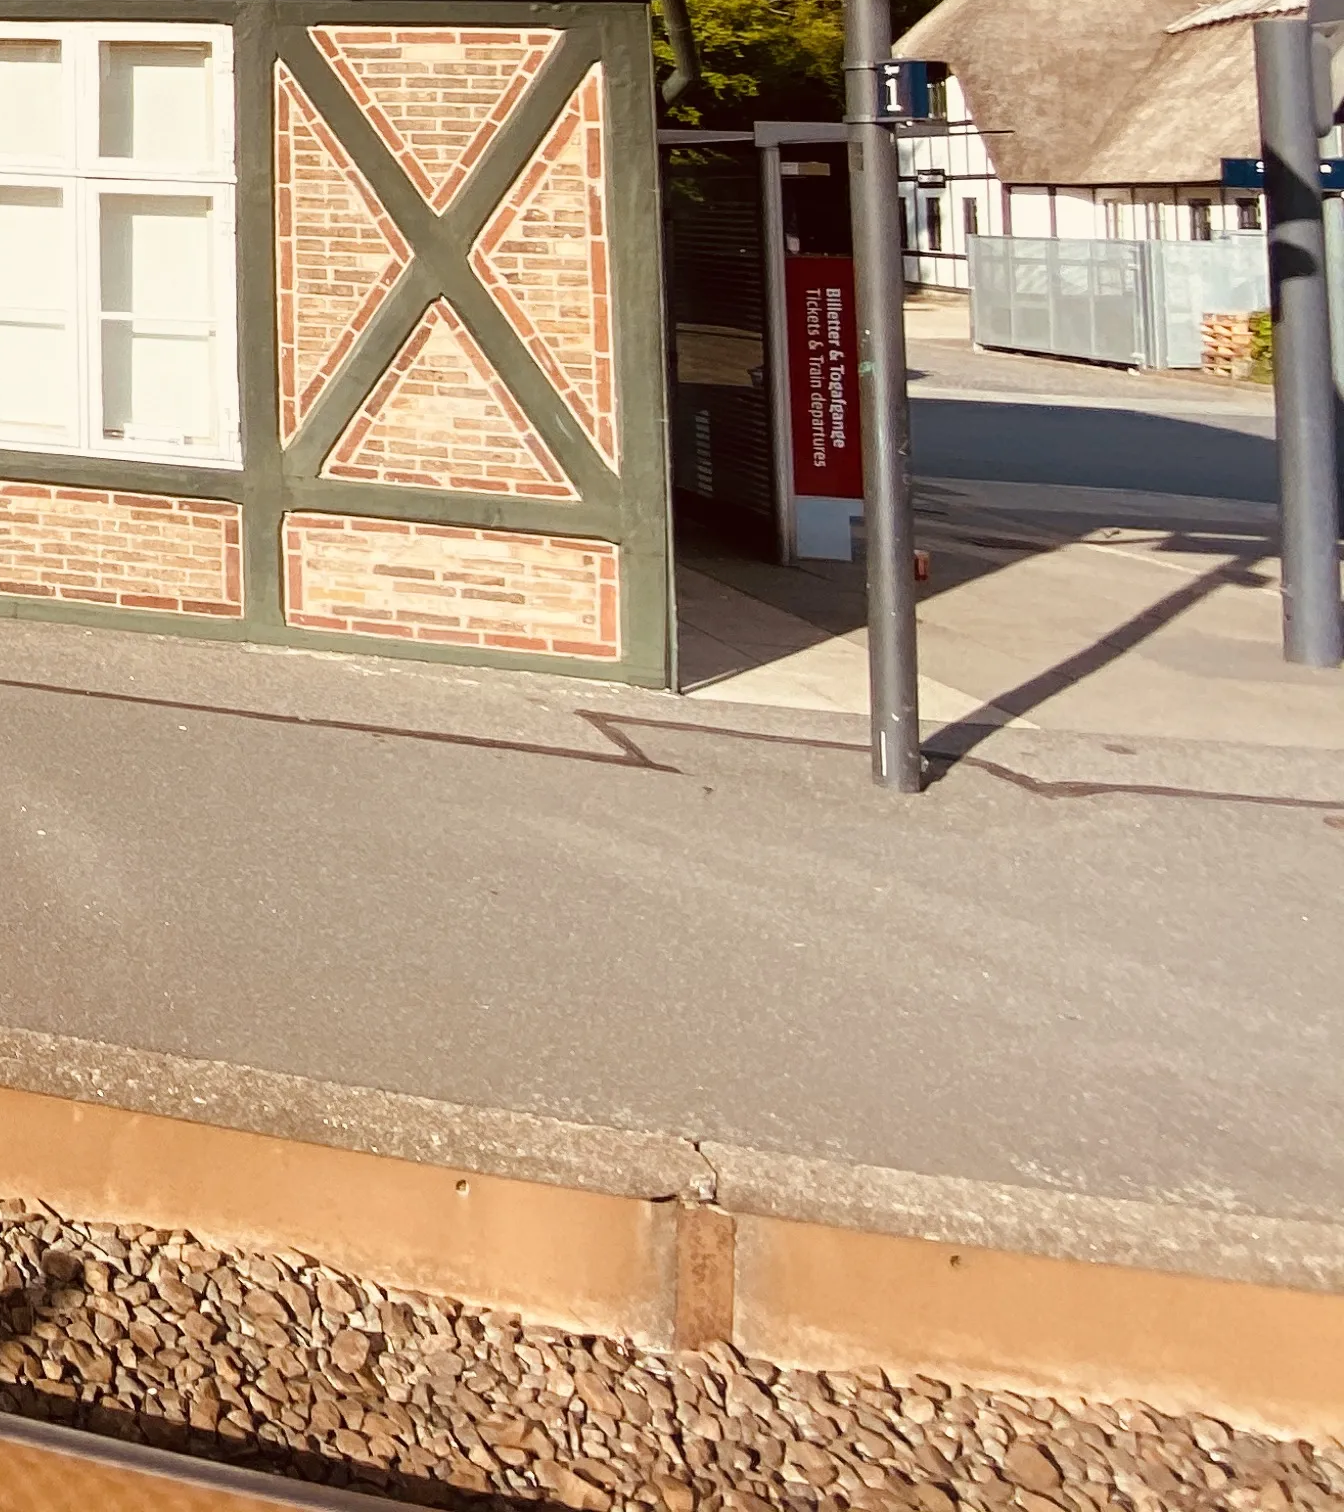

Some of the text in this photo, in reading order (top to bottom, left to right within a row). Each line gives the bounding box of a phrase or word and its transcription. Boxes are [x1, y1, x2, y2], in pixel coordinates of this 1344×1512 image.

[885, 78, 902, 111] 1
[805, 288, 827, 467] Tickets & Train departures
[825, 288, 847, 449] Billetter & Togafgange
